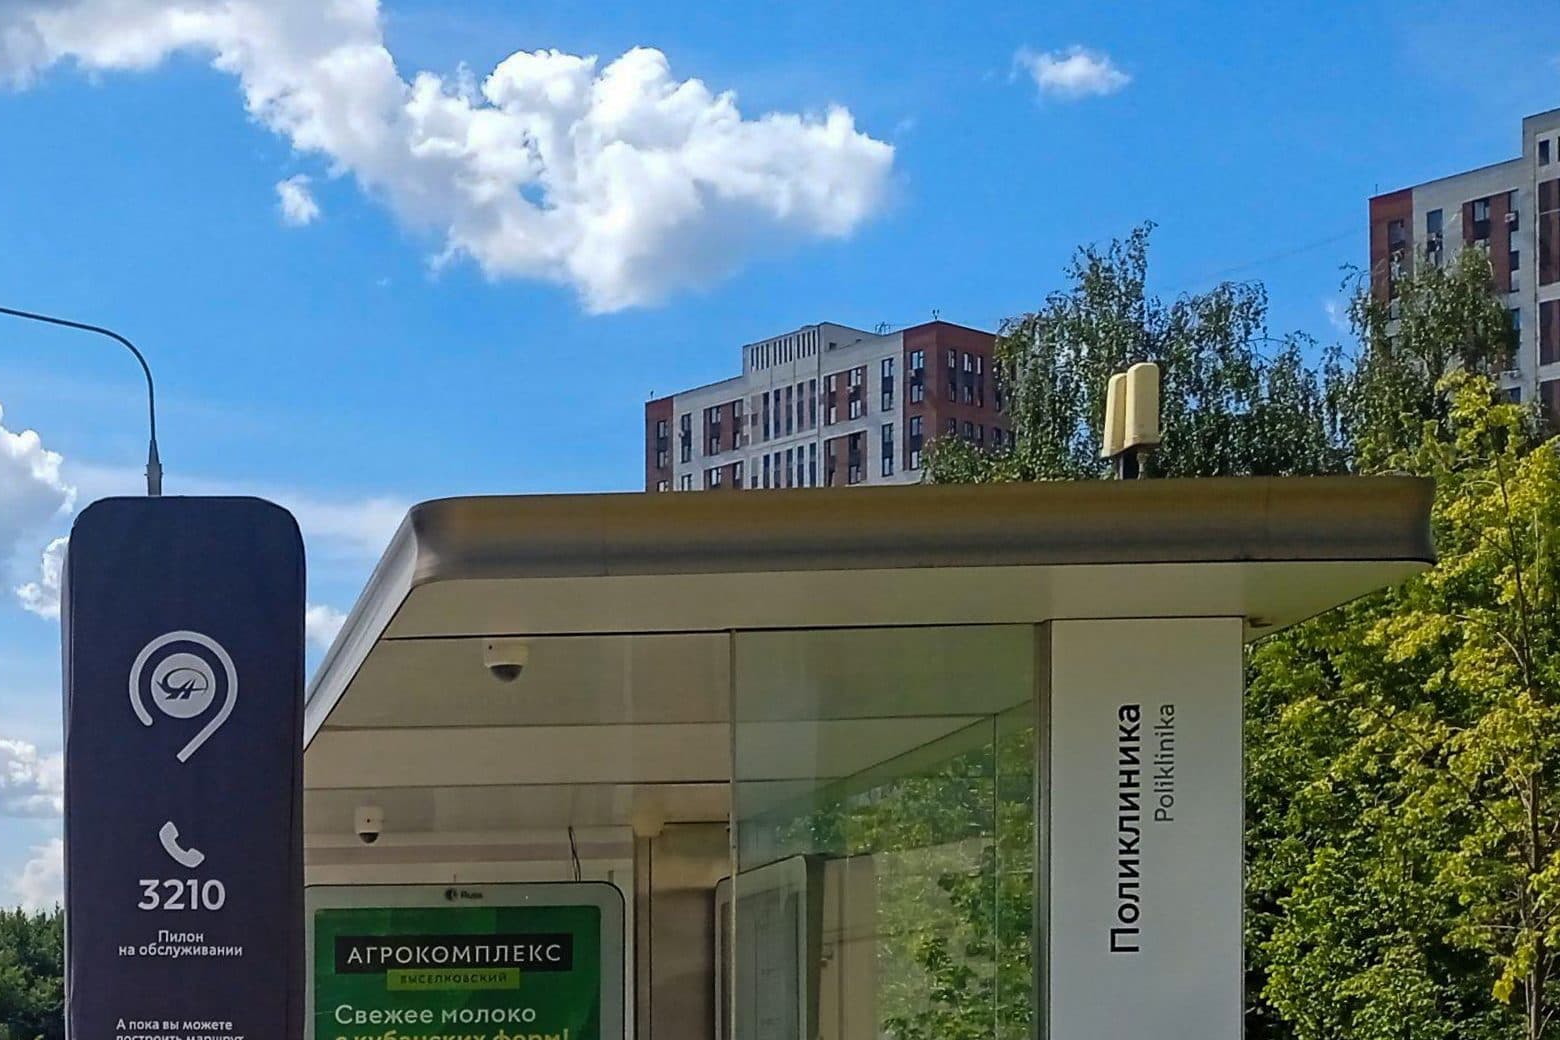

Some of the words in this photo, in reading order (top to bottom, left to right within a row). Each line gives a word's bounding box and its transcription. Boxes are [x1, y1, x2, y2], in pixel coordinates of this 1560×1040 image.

[1154, 703, 1176, 822] Poliklinika
[1110, 703, 1141, 952] Поликлиника
[137, 879, 226, 911] 3210
[158, 930, 204, 942] Пилон
[119, 947, 135, 956] на
[139, 942, 243, 958] обслуживании
[347, 944, 561, 965] АГРОКОМПЛЕКС
[116, 1019, 126, 1030] А
[129, 1021, 159, 1030] пока
[162, 1021, 179, 1030] вы
[182, 1021, 232, 1030] можете
[335, 1005, 433, 1024] Свежее
[441, 1007, 536, 1024] молоко
